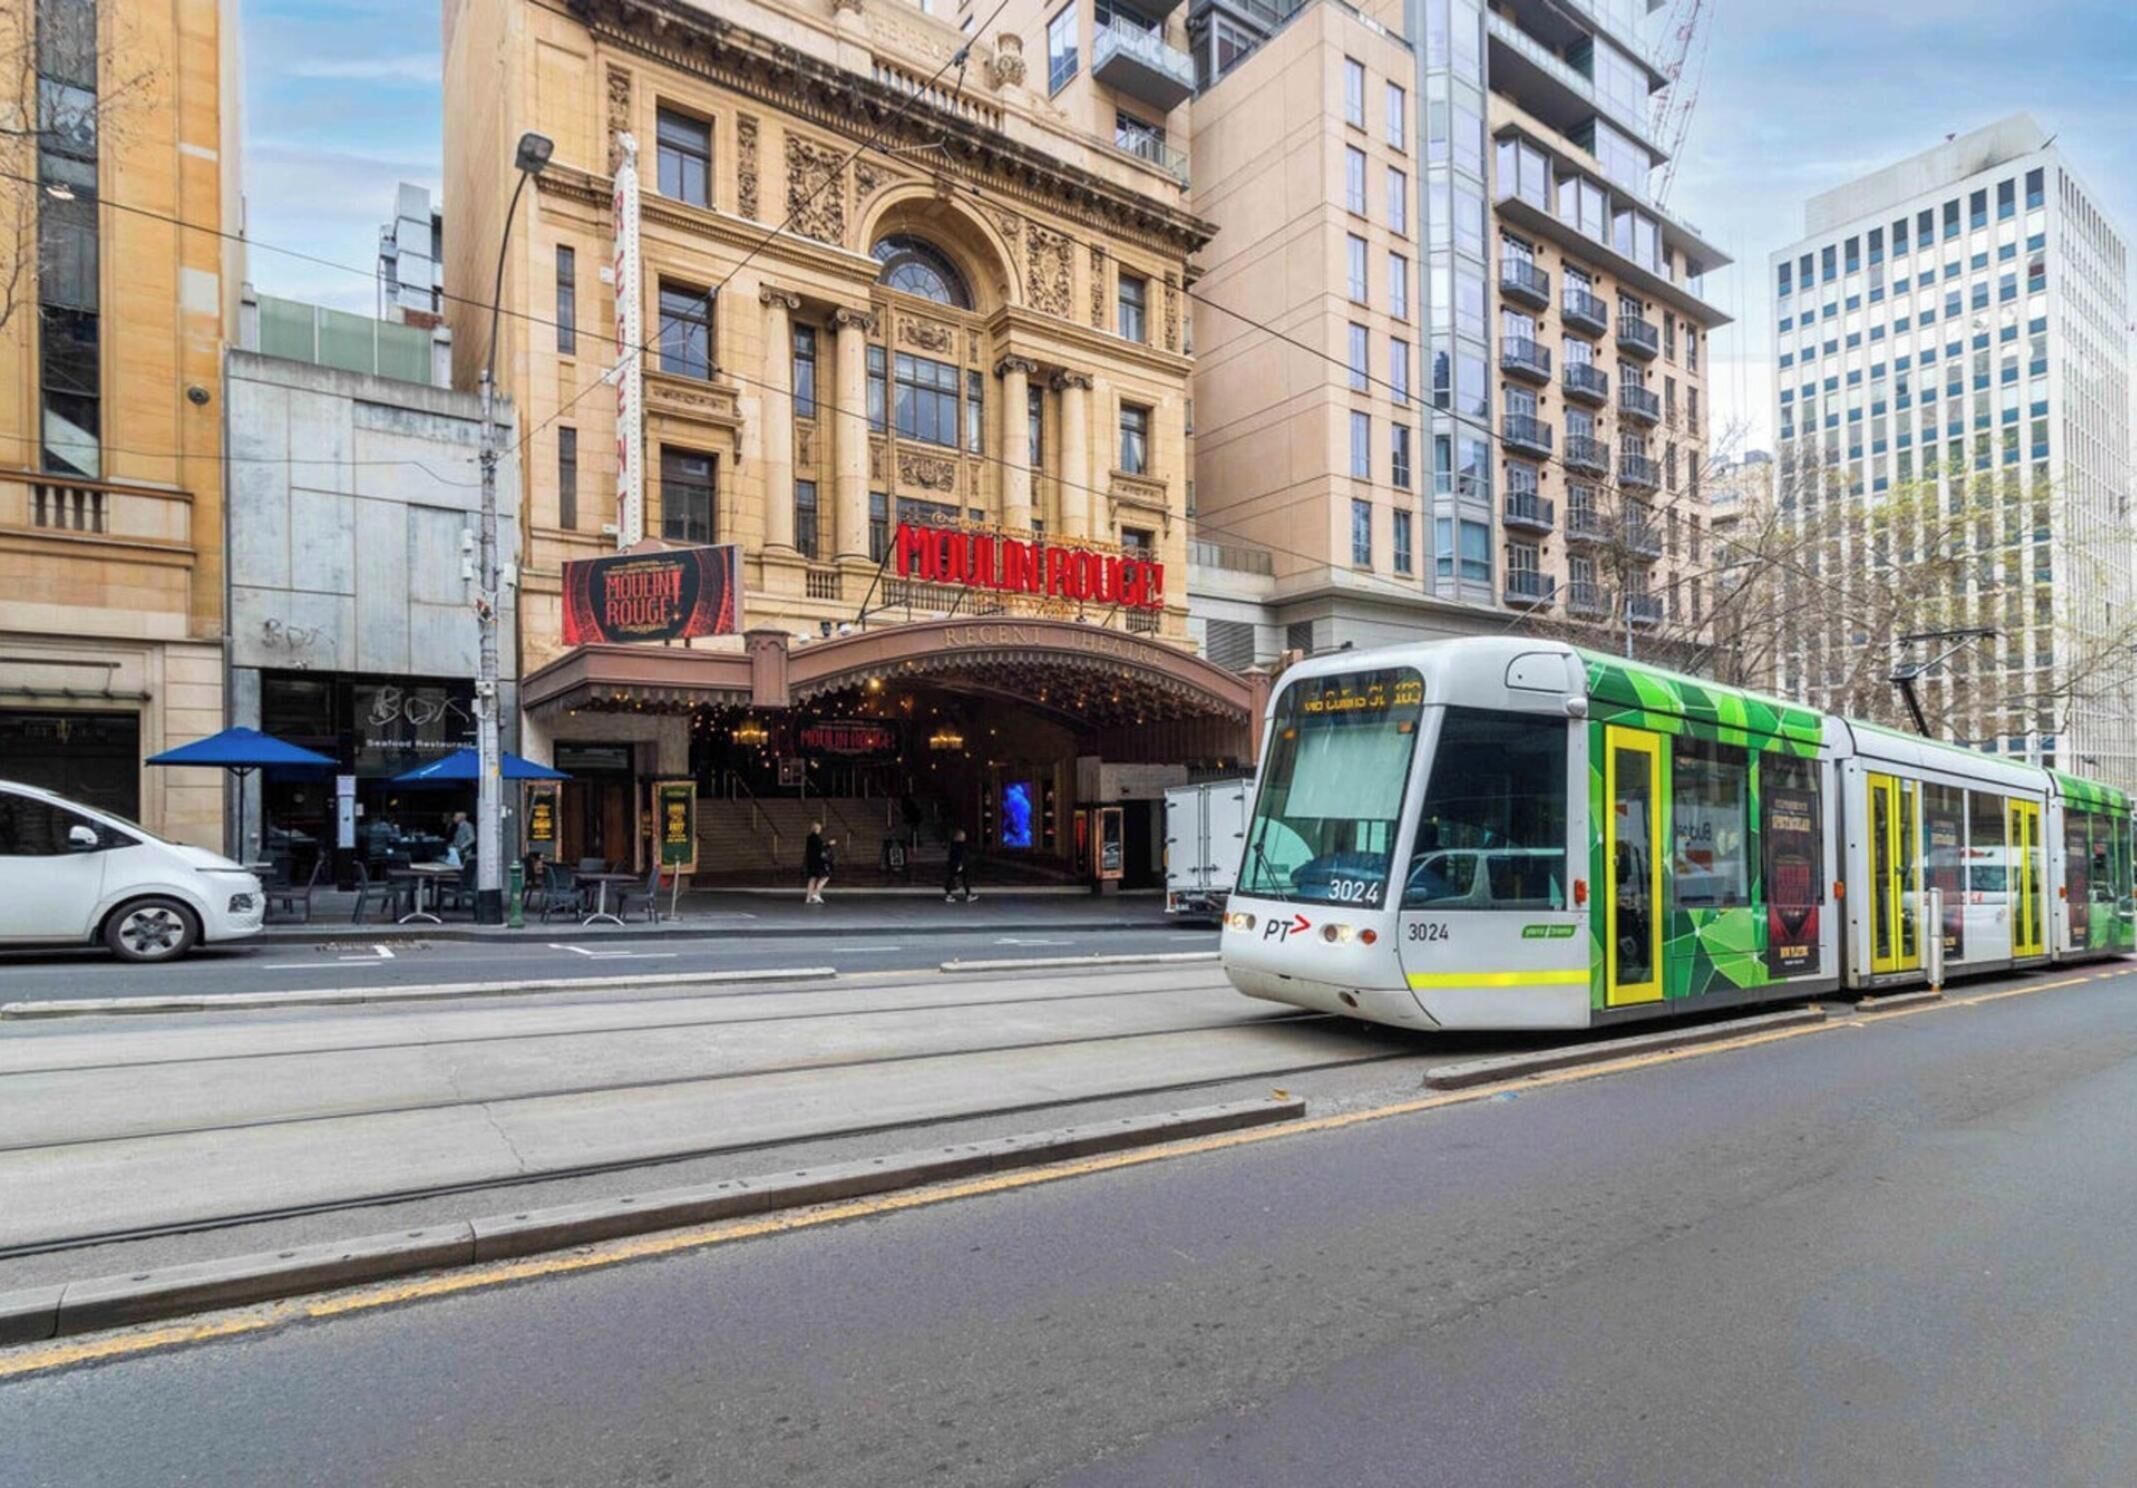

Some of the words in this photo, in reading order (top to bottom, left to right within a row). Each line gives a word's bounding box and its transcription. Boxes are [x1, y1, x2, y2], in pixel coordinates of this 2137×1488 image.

[613, 190, 627, 532] REGENT
[896, 521, 1041, 595] MOULIN
[1046, 546, 1165, 610] ROUGE!
[605, 573, 671, 601] MOULIN
[945, 625, 1042, 647] REGENT
[1070, 630, 1163, 664] THEATRE
[1328, 879, 1379, 904] 3024
[1408, 923, 1449, 942] 3024
